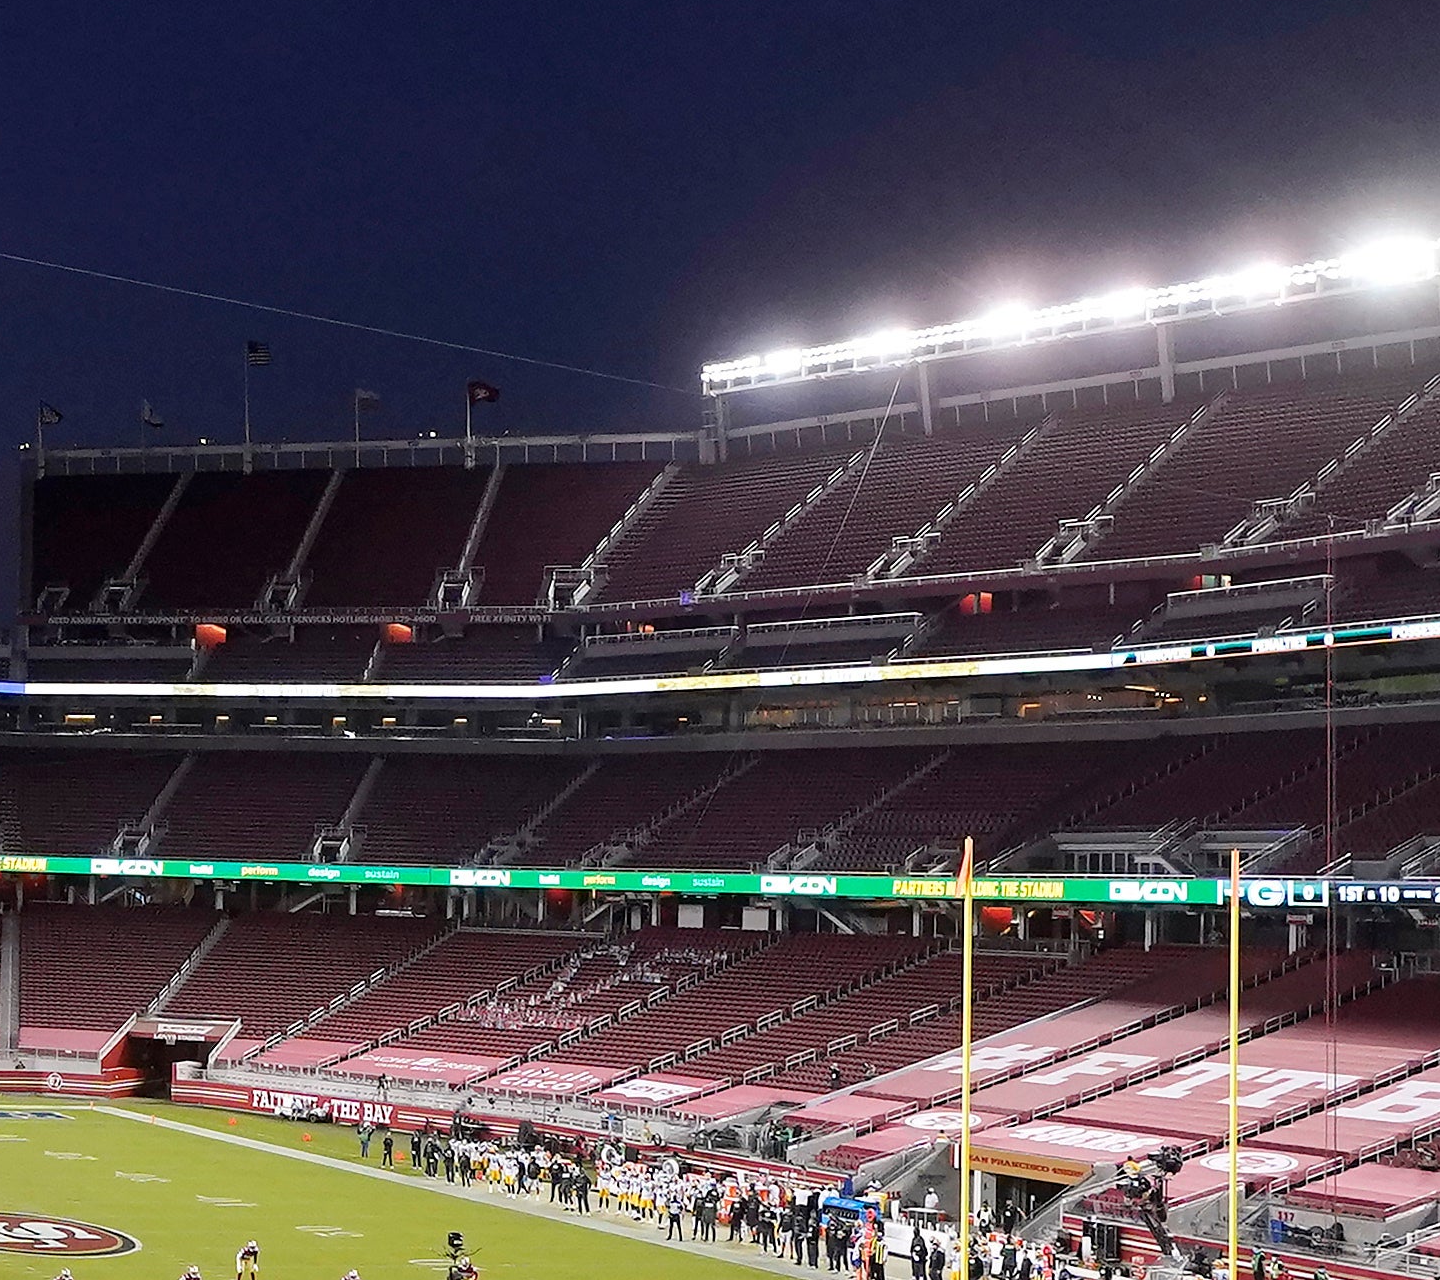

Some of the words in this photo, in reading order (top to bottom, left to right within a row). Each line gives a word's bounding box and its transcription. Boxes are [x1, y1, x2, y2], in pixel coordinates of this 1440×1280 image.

[3, 856, 47, 872] STADIUM
[91, 858, 164, 876] DEVCON
[190, 863, 214, 875] build
[241, 864, 278, 878] perform
[308, 866, 341, 880] design
[364, 868, 400, 880] sustain
[450, 869, 511, 887] DEVCON
[539, 873, 560, 886] build
[583, 873, 616, 888] perform
[641, 875, 671, 889] design
[692, 876, 725, 888] sustain
[761, 875, 837, 895] DEVCON
[892, 878, 945, 897] PARTNERS
[1001, 880, 1019, 898] THE
[1019, 881, 1065, 899] STADIUM
[1109, 881, 1188, 902] DEVCON
[1249, 883, 1284, 905] G
[1302, 884, 1316, 902] 0
[1338, 884, 1365, 903] 1ST
[1379, 884, 1401, 903] 10
[497, 1075, 574, 1092] CISCO
[331, 1098, 360, 1119] THE
[364, 1103, 393, 1124] BAY
[1009, 1124, 1165, 1154] 49ERS
[989, 1157, 1049, 1173] FRANCISCO
[1277, 1211, 1295, 1221] 117
